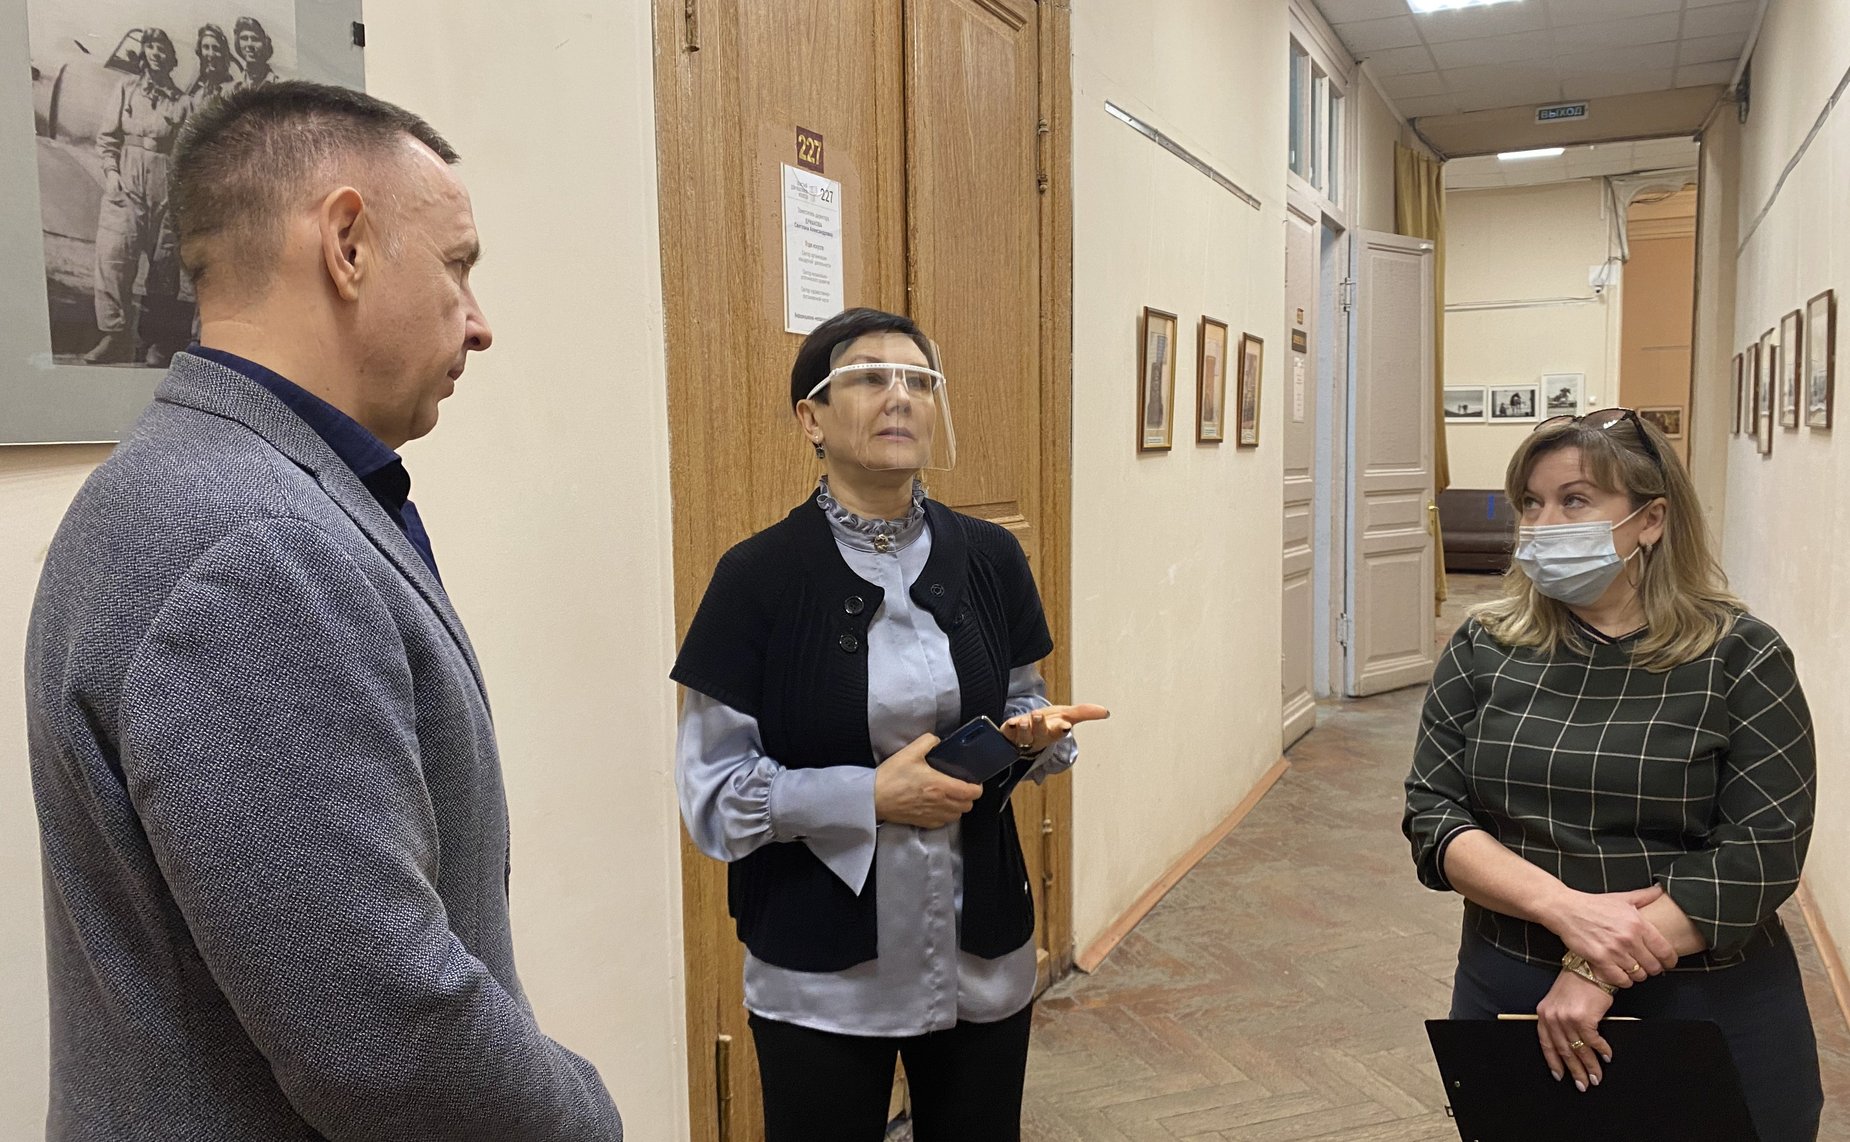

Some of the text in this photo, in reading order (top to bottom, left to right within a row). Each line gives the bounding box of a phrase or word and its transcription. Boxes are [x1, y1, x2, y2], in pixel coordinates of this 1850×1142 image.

[1540, 106, 1582, 119] ВЫХОД
[798, 134, 822, 165] 227
[820, 188, 834, 204] 227
